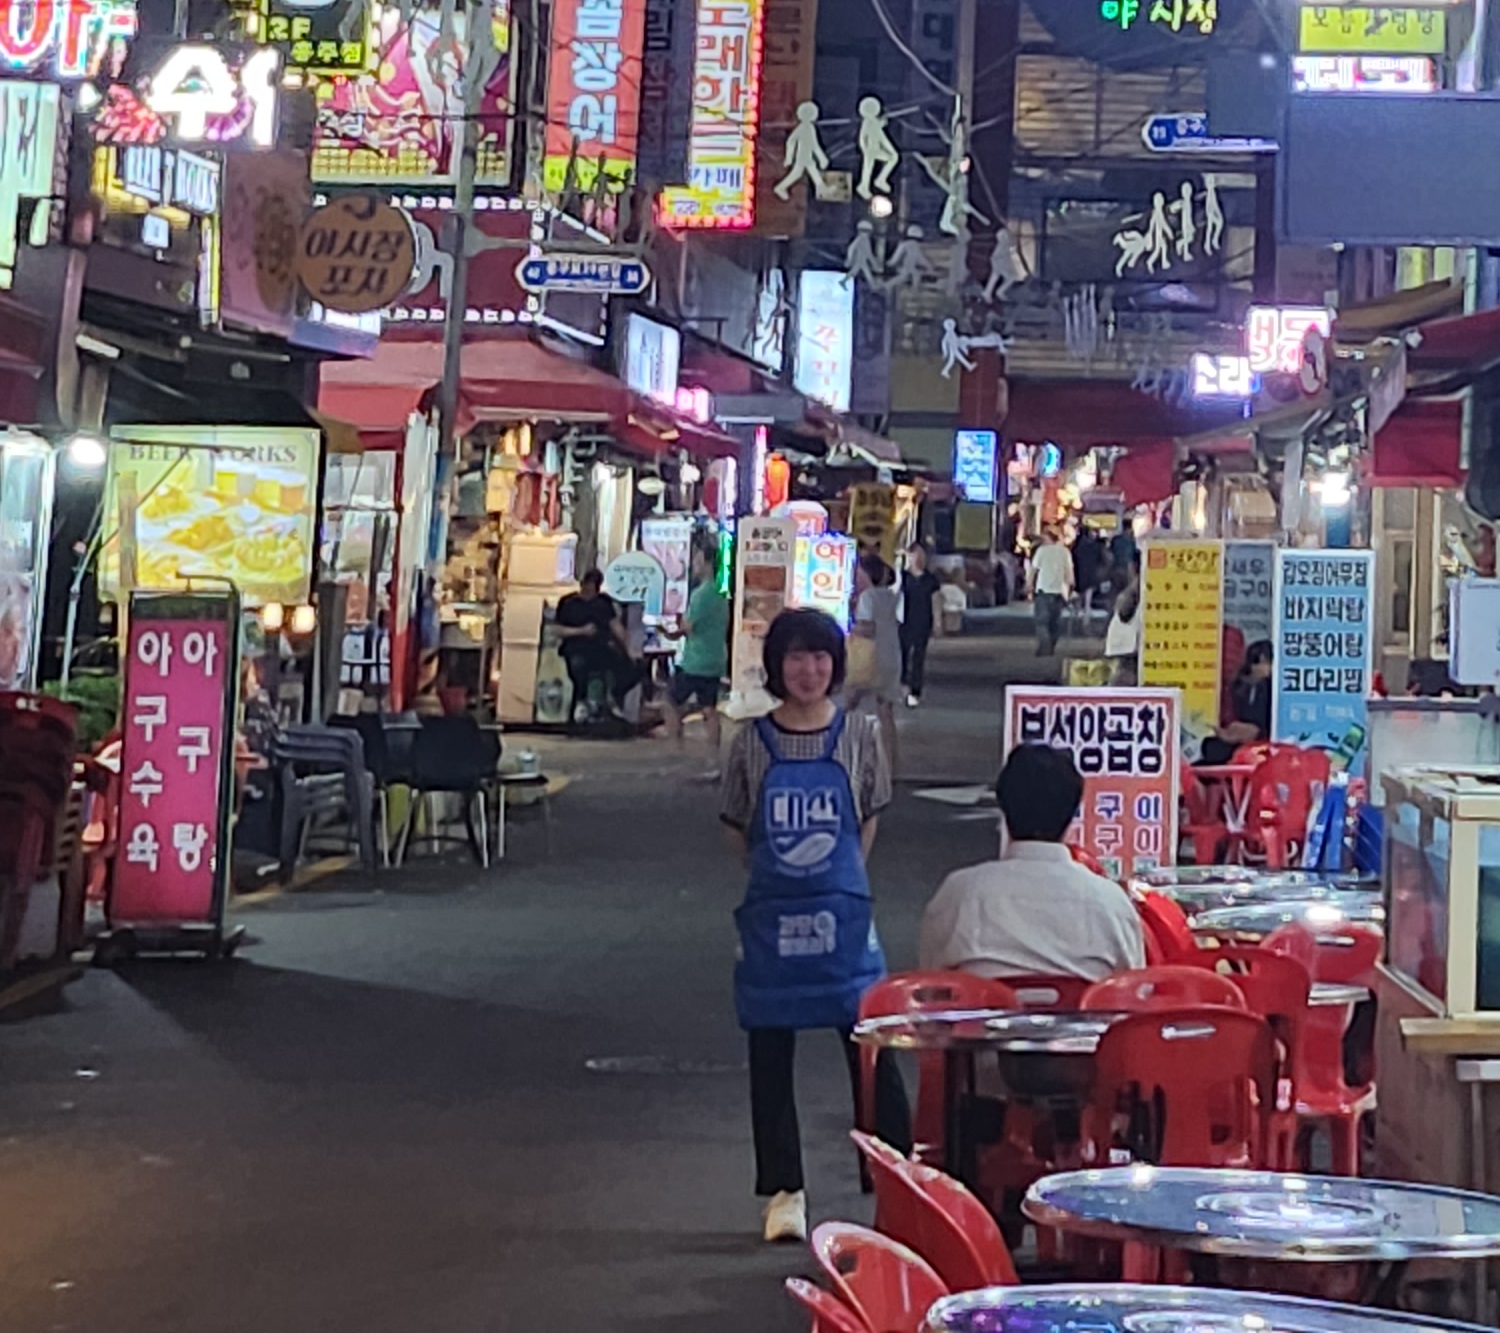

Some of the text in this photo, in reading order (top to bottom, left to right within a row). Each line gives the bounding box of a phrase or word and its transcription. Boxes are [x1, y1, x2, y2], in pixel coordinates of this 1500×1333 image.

[129, 444, 298, 464] BEER WORKS
[127, 630, 173, 873] 아구수육
[172, 630, 218, 872] 아구탕
